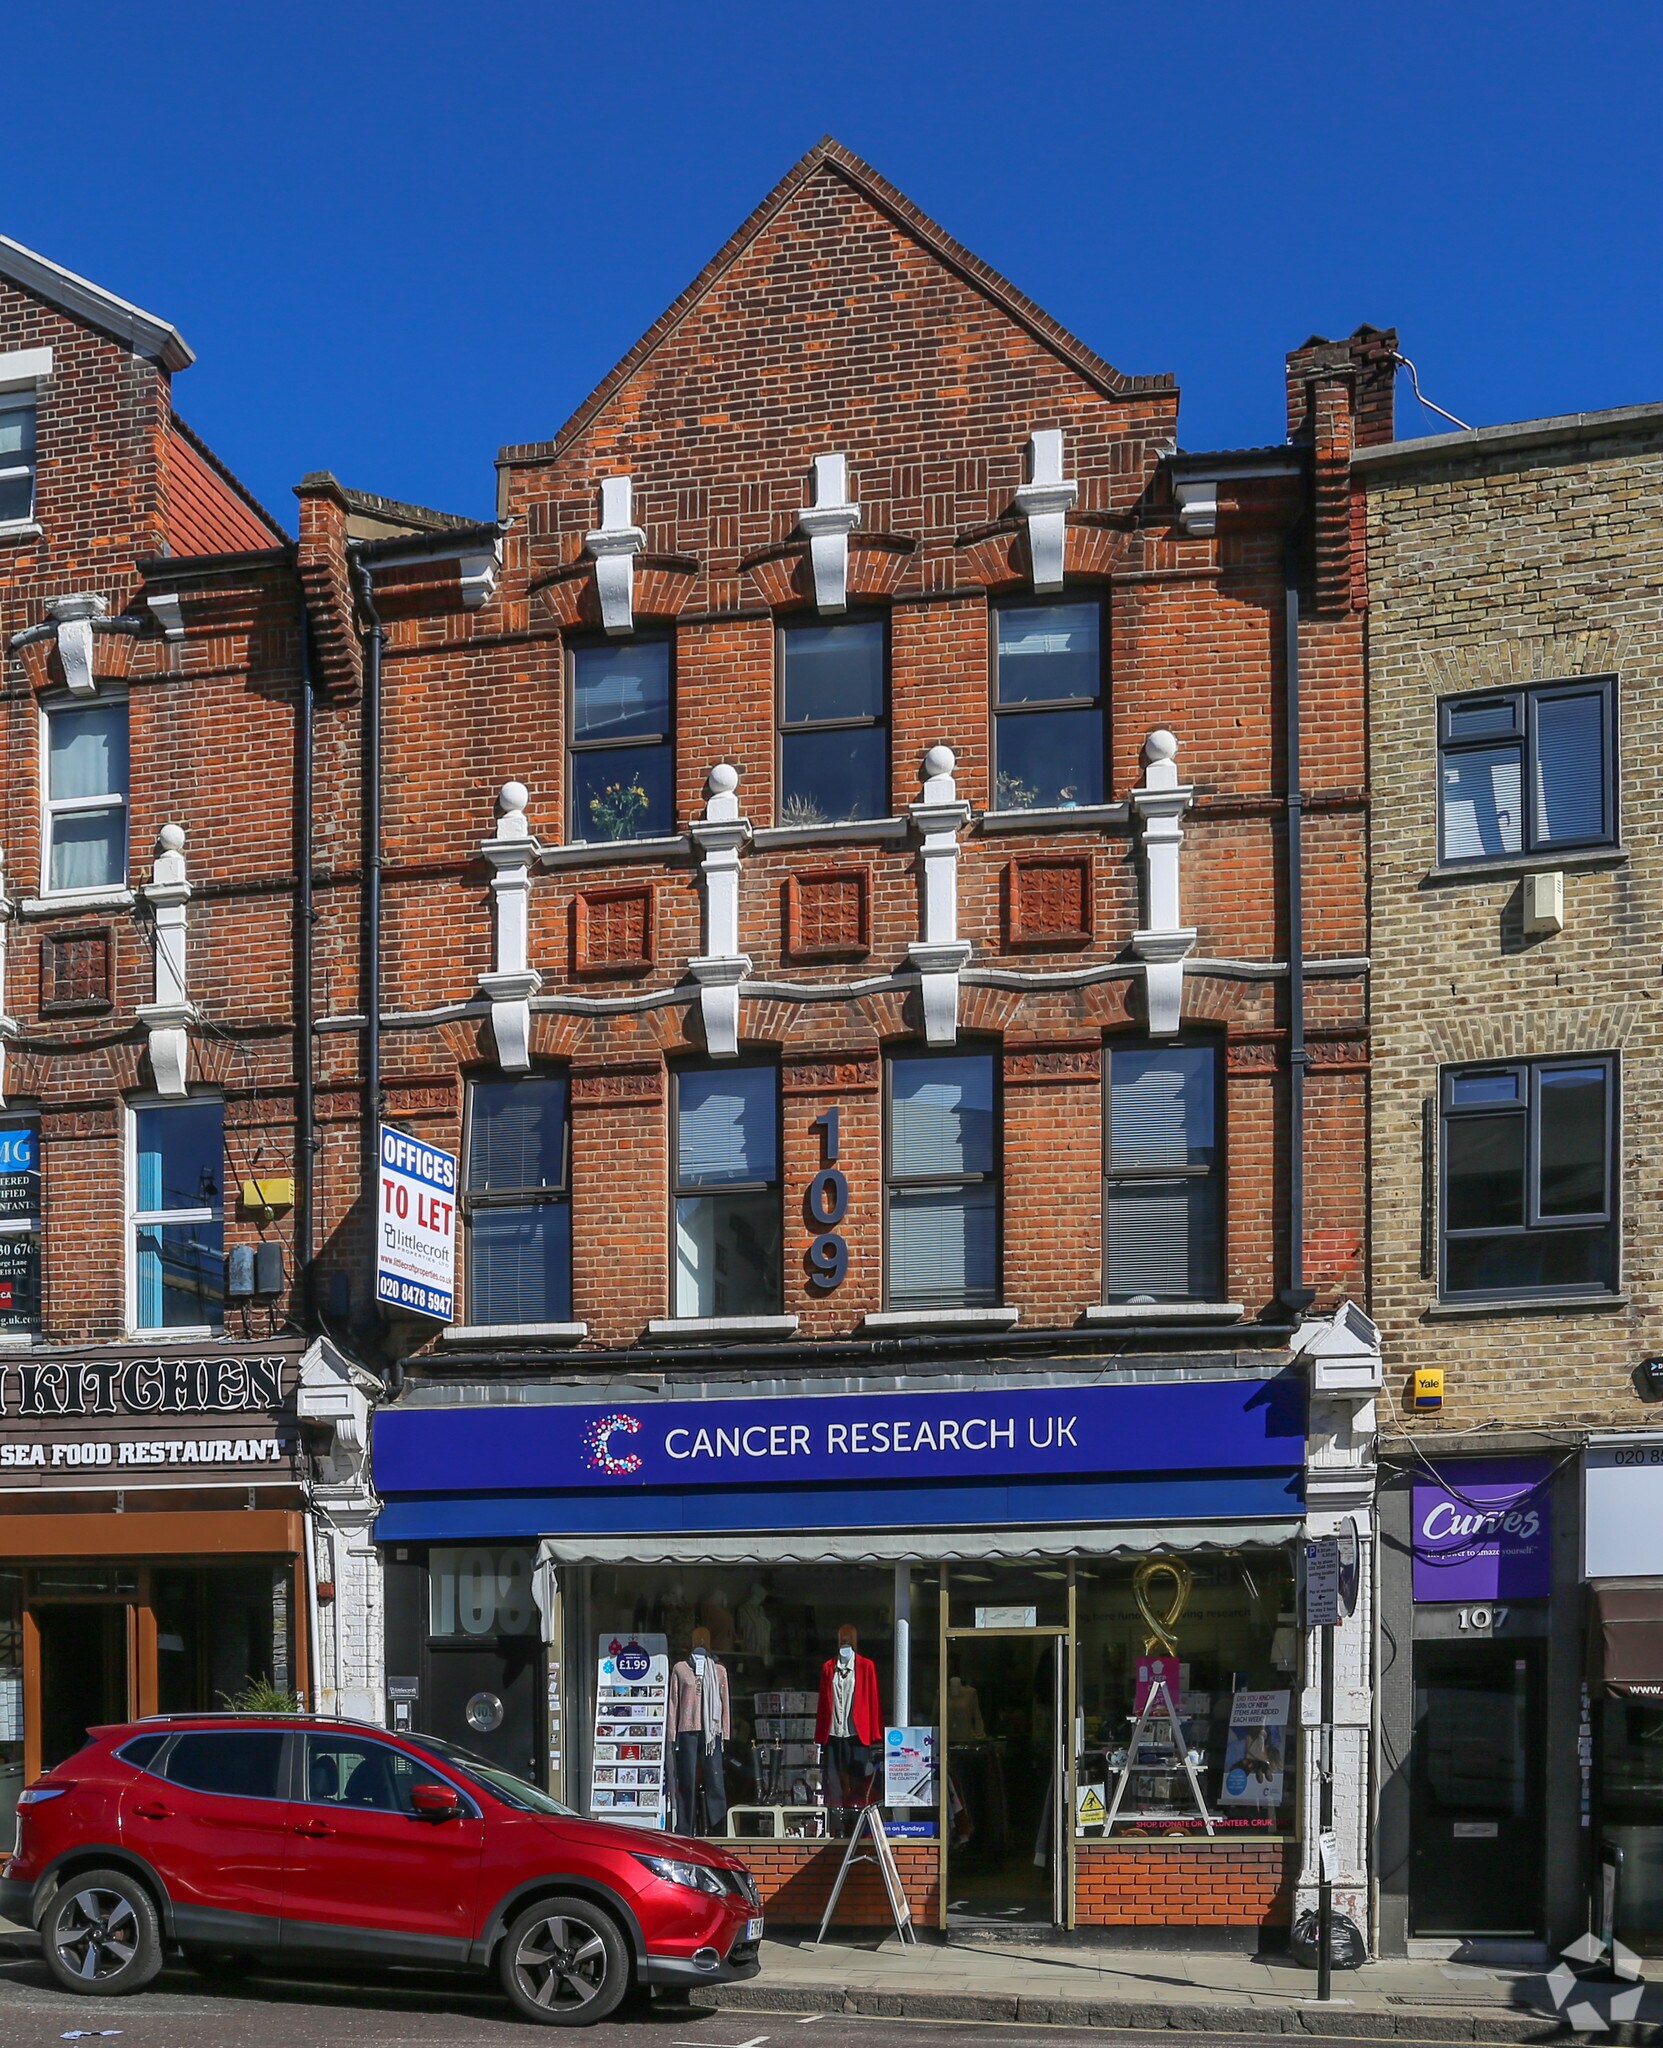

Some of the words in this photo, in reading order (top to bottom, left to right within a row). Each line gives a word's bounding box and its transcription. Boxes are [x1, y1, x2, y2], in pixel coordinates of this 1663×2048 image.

[384, 1135, 453, 1188] OFFICES
[383, 1178, 408, 1219] TO
[418, 1192, 453, 1236] LET
[811, 1106, 848, 1288] 109
[397, 1229, 449, 1262] littlecroft
[397, 1246, 435, 1263] PROPERTIES
[439, 1259, 449, 1268] LTD
[380, 1276, 399, 1298] 020
[402, 1283, 426, 1307] 8478
[428, 1291, 451, 1315] 5947
[18, 1357, 286, 1415] KITCHEN
[1419, 1379, 1440, 1388] Yale
[665, 1423, 812, 1459] CANCER
[827, 1417, 1016, 1455] RESEARCH
[1029, 1415, 1079, 1448] UK
[0, 1444, 46, 1466] SEA
[51, 1442, 112, 1465] FOOD
[118, 1439, 286, 1464] RESTAURANT
[1615, 1450, 1645, 1464] 020
[1422, 1502, 1540, 1540] Curves
[1467, 1549, 1477, 1557] to
[1477, 1548, 1500, 1556] amaze
[1206, 1608, 1250, 1618] research
[1459, 1608, 1509, 1628] 107
[619, 1660, 648, 1670] £1.99
[901, 1825, 925, 1833] Sundays
[1136, 1821, 1158, 1829] SHOP,
[1159, 1820, 1190, 1828] DONATE
[1191, 1820, 1203, 1828] OR
